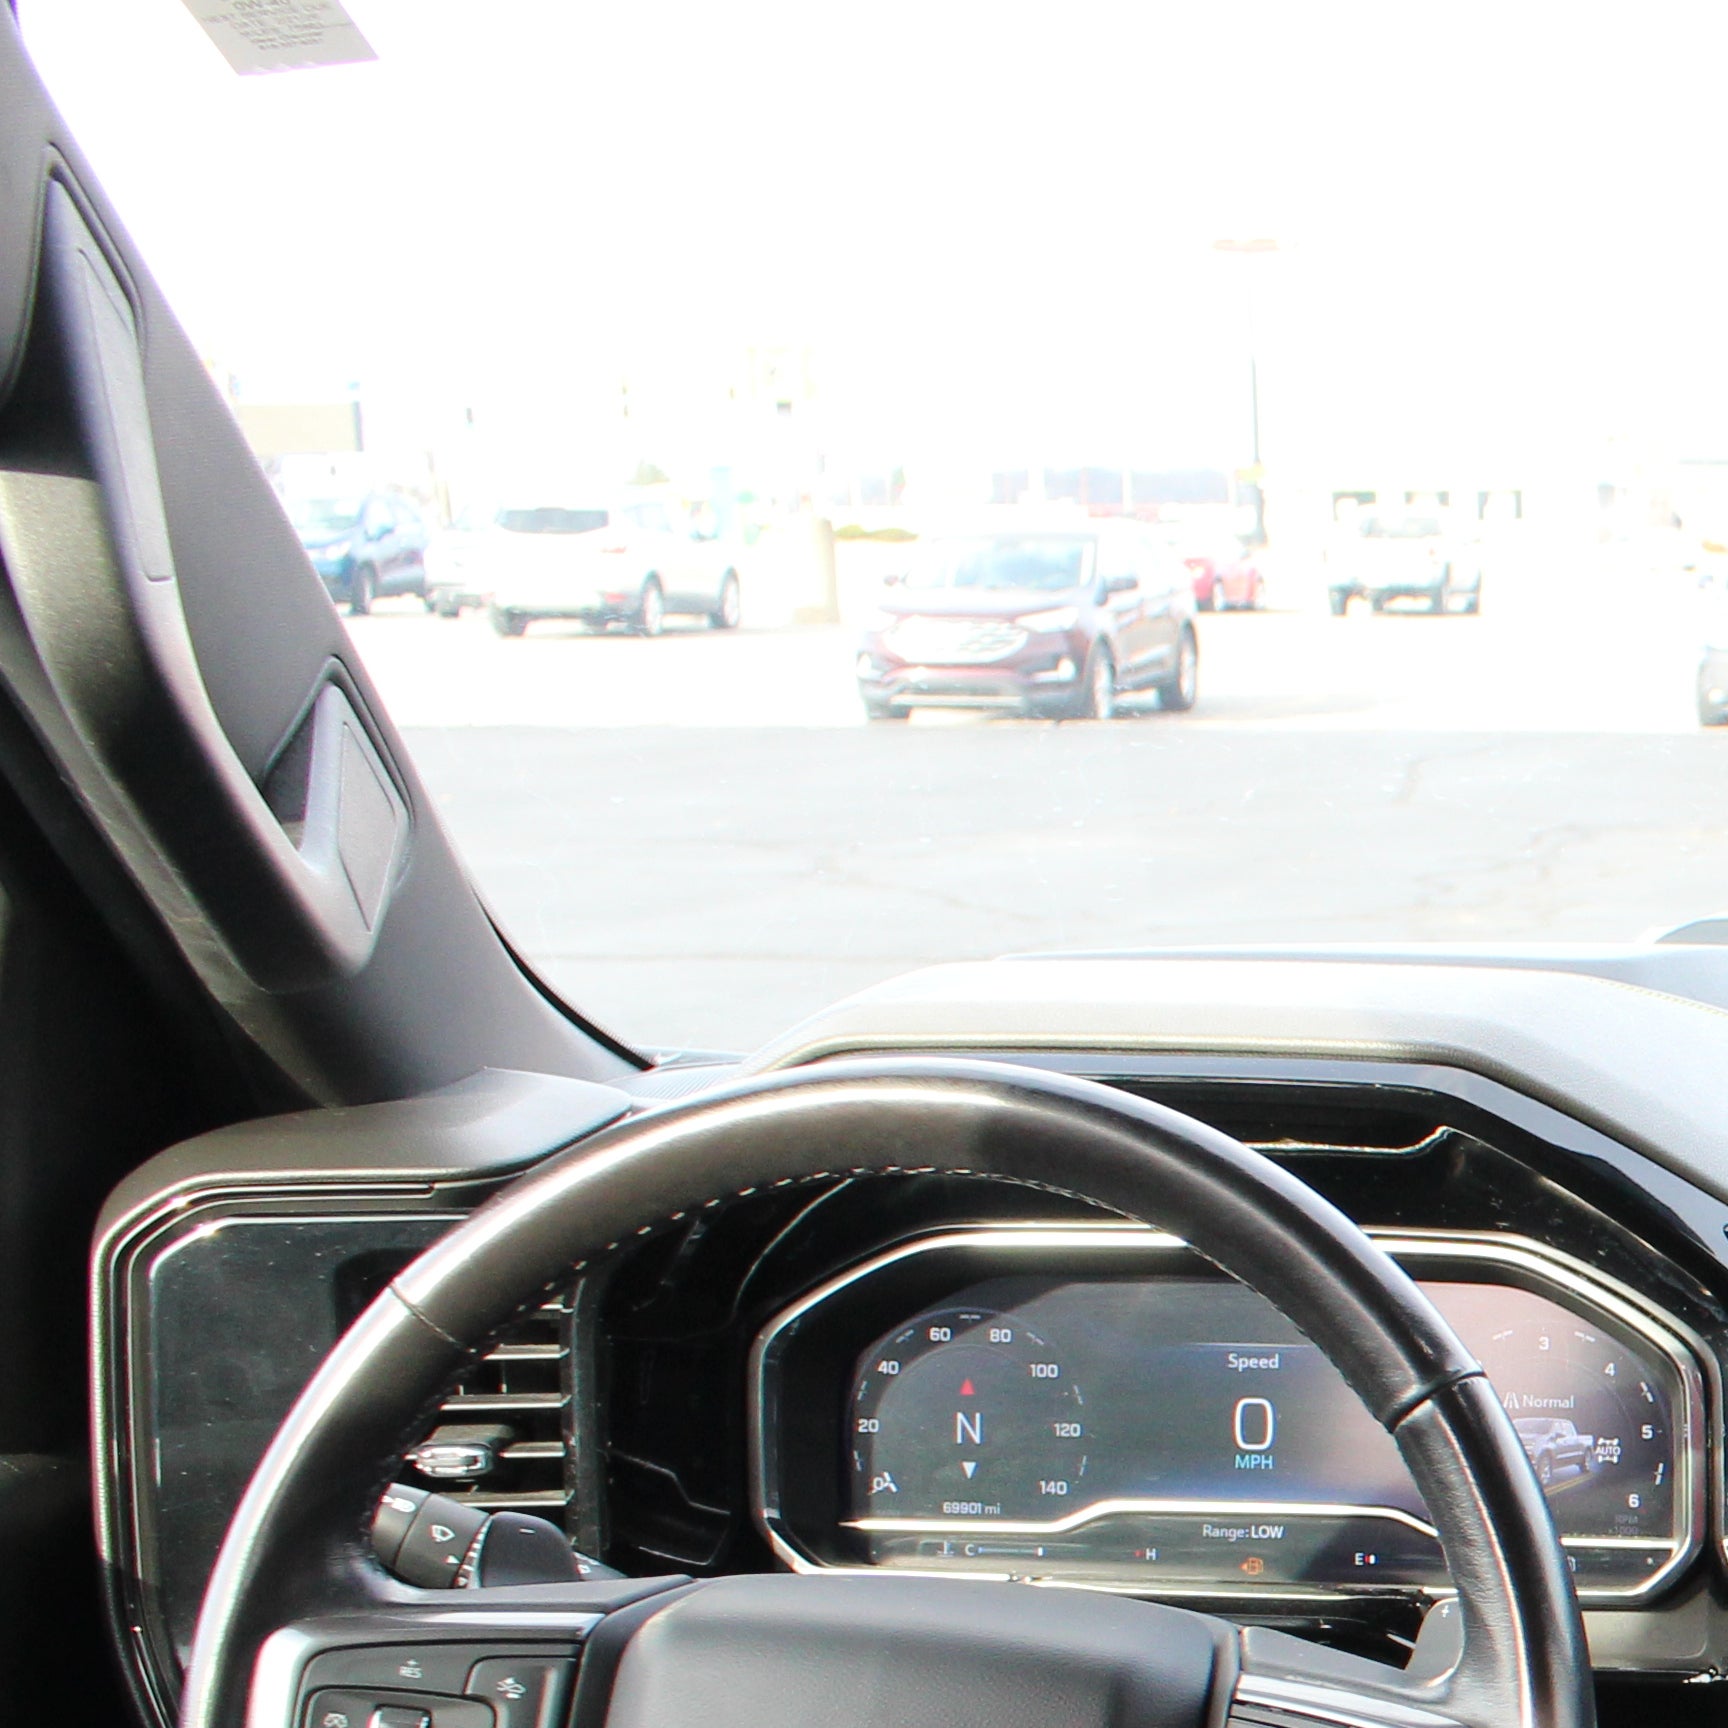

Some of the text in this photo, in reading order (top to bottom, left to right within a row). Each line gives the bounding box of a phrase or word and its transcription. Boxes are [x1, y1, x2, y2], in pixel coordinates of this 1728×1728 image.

[929, 1327, 951, 1342] 60
[990, 1328, 1012, 1343] 80
[1539, 1336, 1549, 1350] 3
[877, 1360, 899, 1375] 40
[1227, 1353, 1279, 1372] Speed
[1030, 1363, 1059, 1378] 100
[1604, 1363, 1615, 1377] 4
[1523, 1395, 1574, 1409] Normal
[858, 1418, 879, 1433] 20
[956, 1411, 981, 1444] N
[1054, 1423, 1081, 1437] 120
[1234, 1397, 1274, 1450] 0
[1641, 1425, 1653, 1439] 5
[1595, 1445, 1621, 1456] AUTO
[1235, 1454, 1273, 1469] MPH
[1040, 1481, 1068, 1495] 140
[943, 1501, 1001, 1514] 69901 mi
[1628, 1493, 1640, 1508] 6
[965, 1544, 975, 1556] C
[1145, 1548, 1156, 1560] H
[1354, 1553, 1364, 1565] E
[399, 1666, 422, 1679] RES
